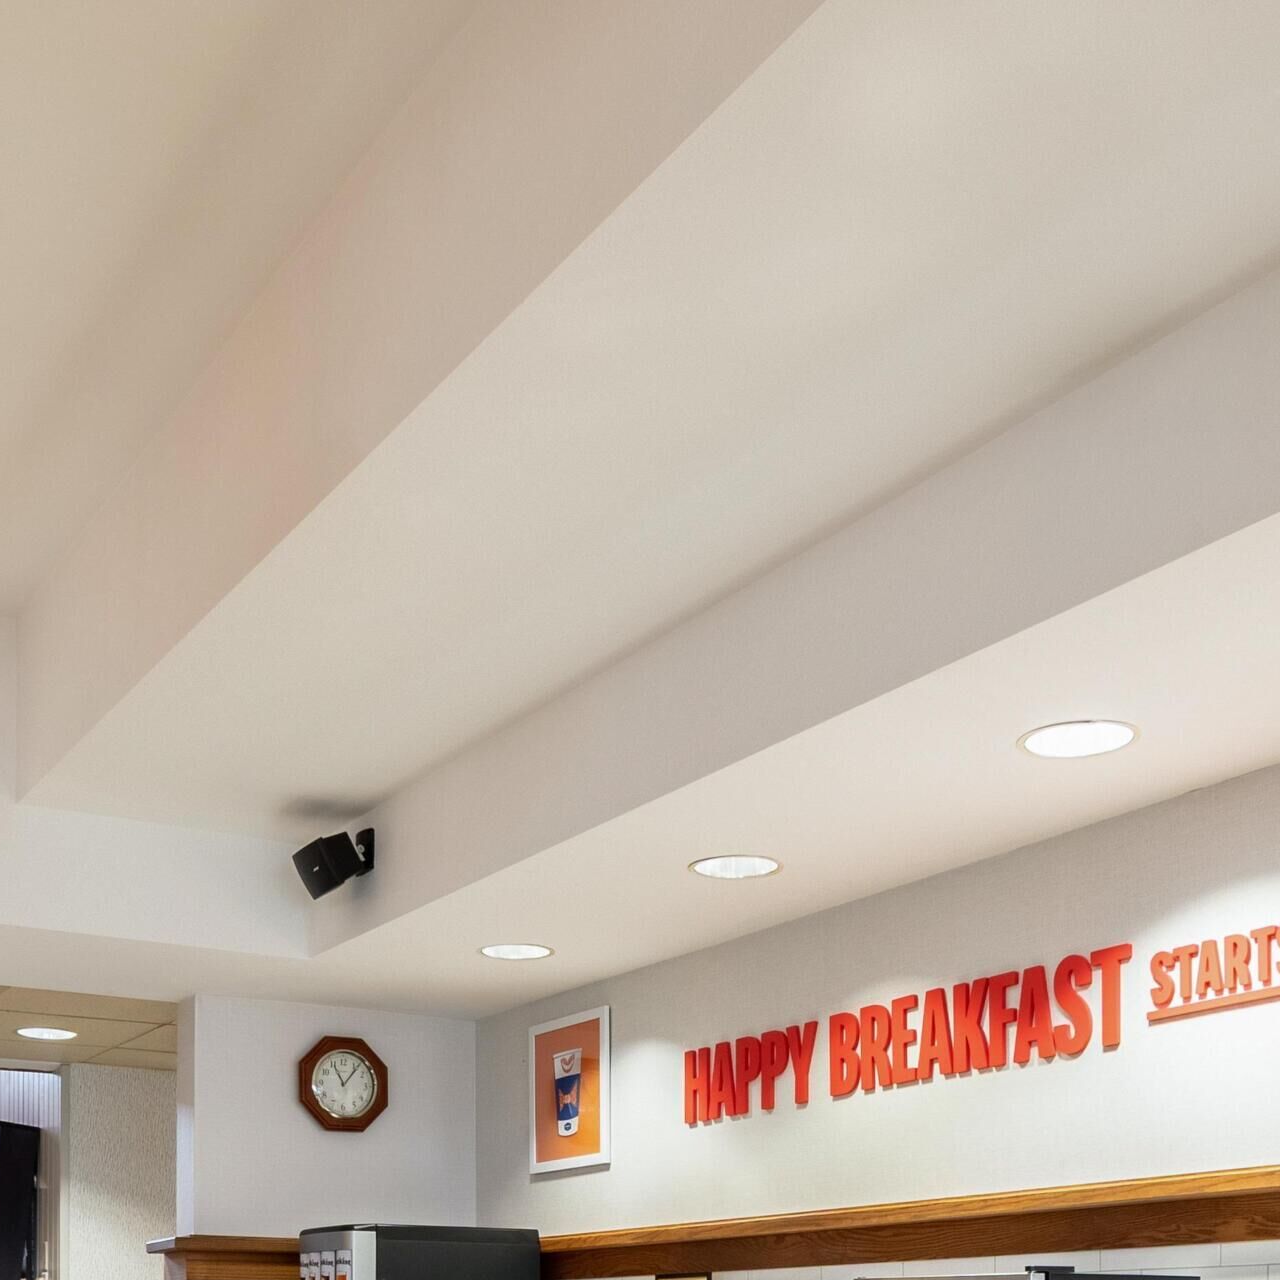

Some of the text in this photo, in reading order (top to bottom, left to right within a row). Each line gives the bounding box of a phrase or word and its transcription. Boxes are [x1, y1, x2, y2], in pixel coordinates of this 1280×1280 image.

[684, 1021, 818, 1125] HAPPY
[829, 943, 1132, 1097] BREAKFAST
[340, 1058, 348, 1067] 12
[322, 1068, 330, 1077] 10
